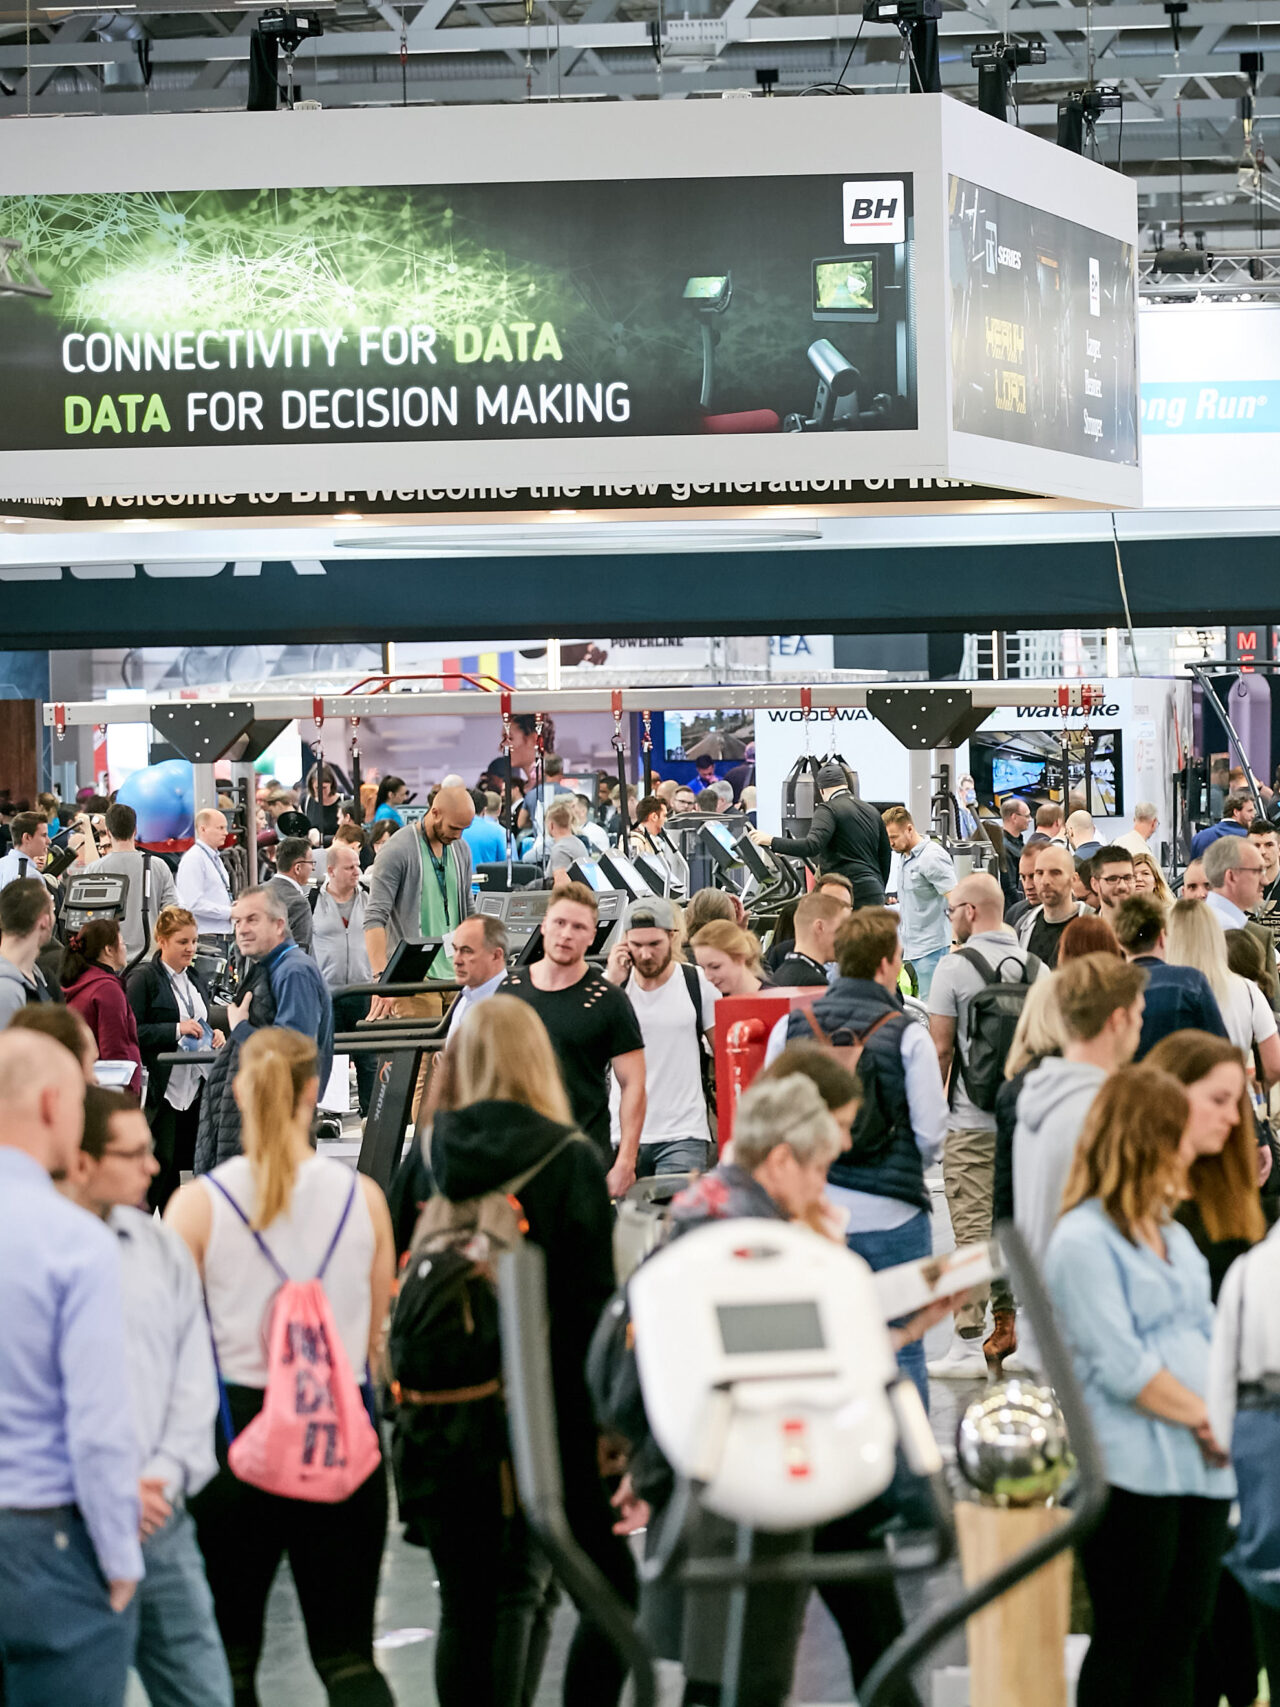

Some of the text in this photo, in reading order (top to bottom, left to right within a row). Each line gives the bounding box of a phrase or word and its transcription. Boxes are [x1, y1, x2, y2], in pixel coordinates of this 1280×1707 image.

[851, 197, 898, 221] BH
[997, 245, 1022, 270] SERIES
[62, 321, 563, 374] CONNECTIVITY FOR DATA
[64, 382, 631, 435] DATA FOR DECISION MAKING
[768, 709, 879, 722] WOODWA
